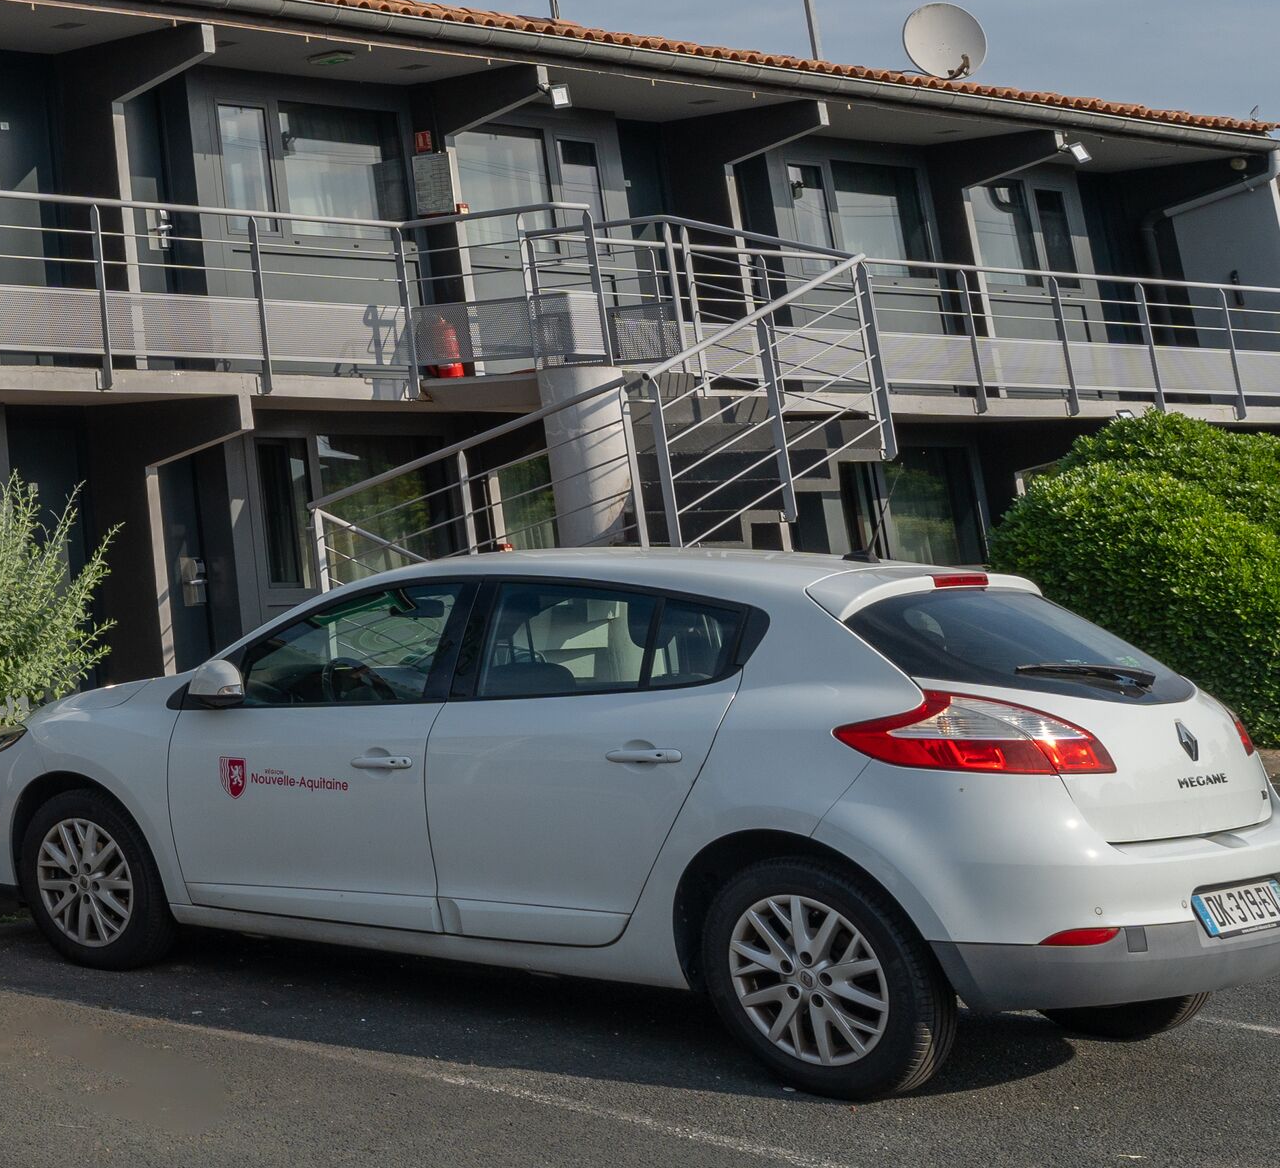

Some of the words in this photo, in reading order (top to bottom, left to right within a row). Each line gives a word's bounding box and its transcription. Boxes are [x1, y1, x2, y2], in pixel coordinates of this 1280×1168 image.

[251, 772, 349, 792] Nouvelle-Aquitaine
[1177, 773, 1229, 789] MEGANE
[1203, 885, 1280, 928] DK-319-EV
